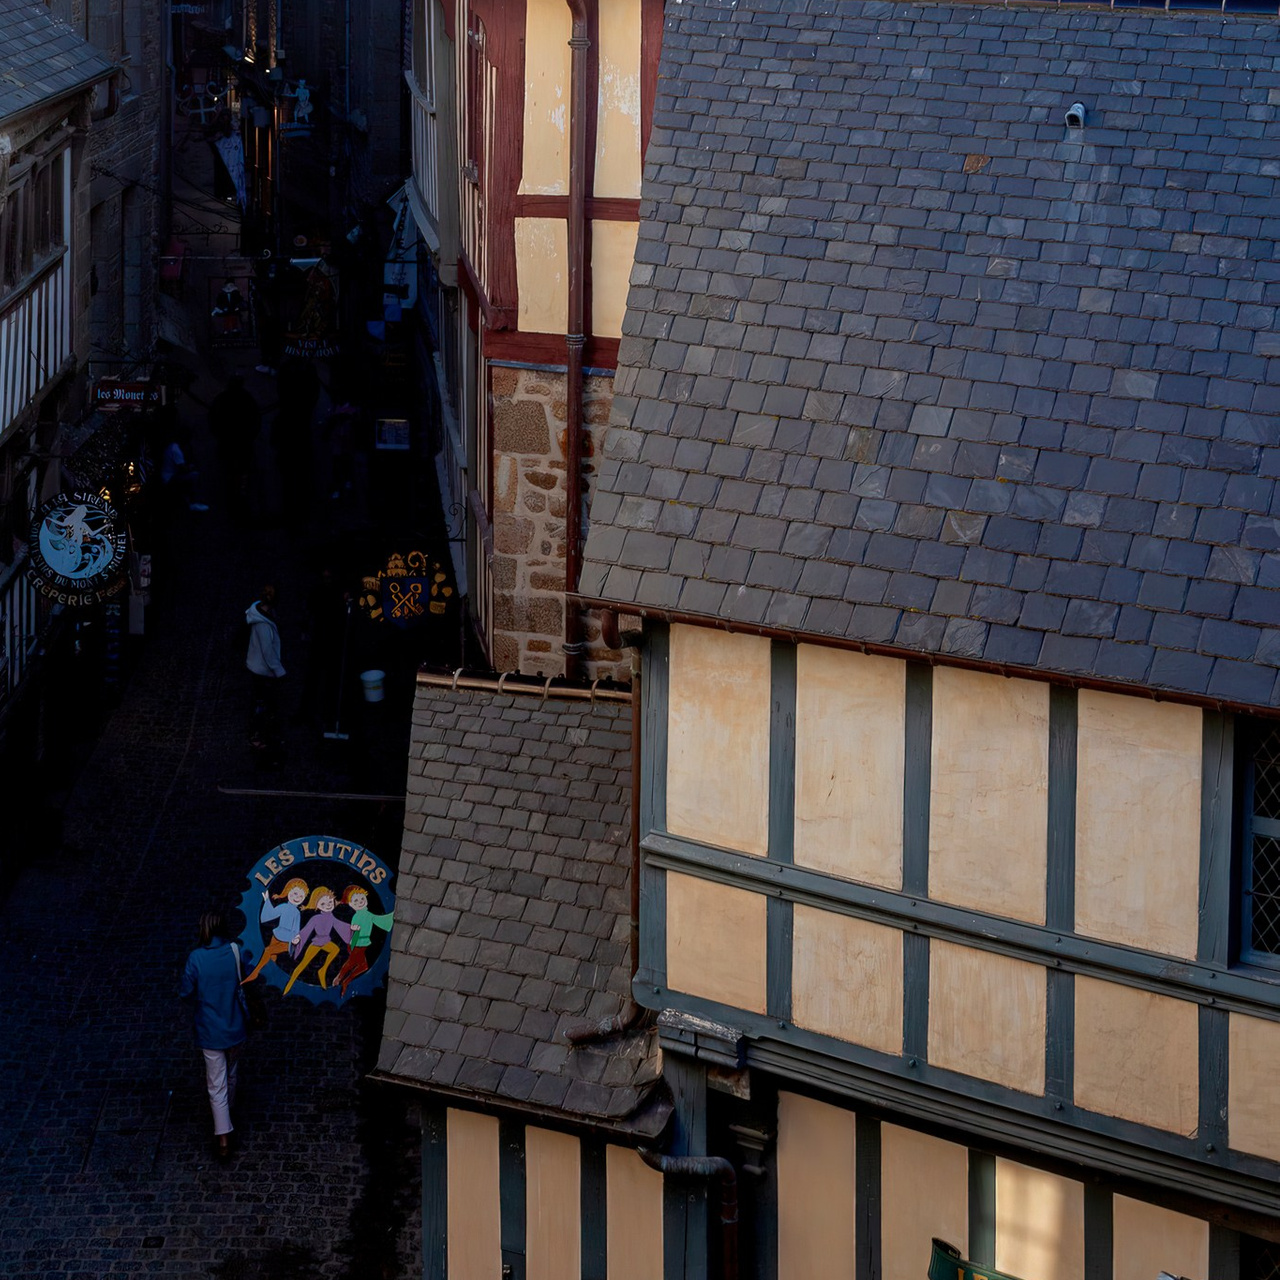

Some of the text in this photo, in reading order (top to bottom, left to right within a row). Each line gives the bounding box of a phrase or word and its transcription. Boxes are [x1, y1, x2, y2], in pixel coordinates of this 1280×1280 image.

[113, 388, 159, 401] Mouets
[54, 575, 68, 587] DU
[255, 841, 387, 887] LES LUTINS
